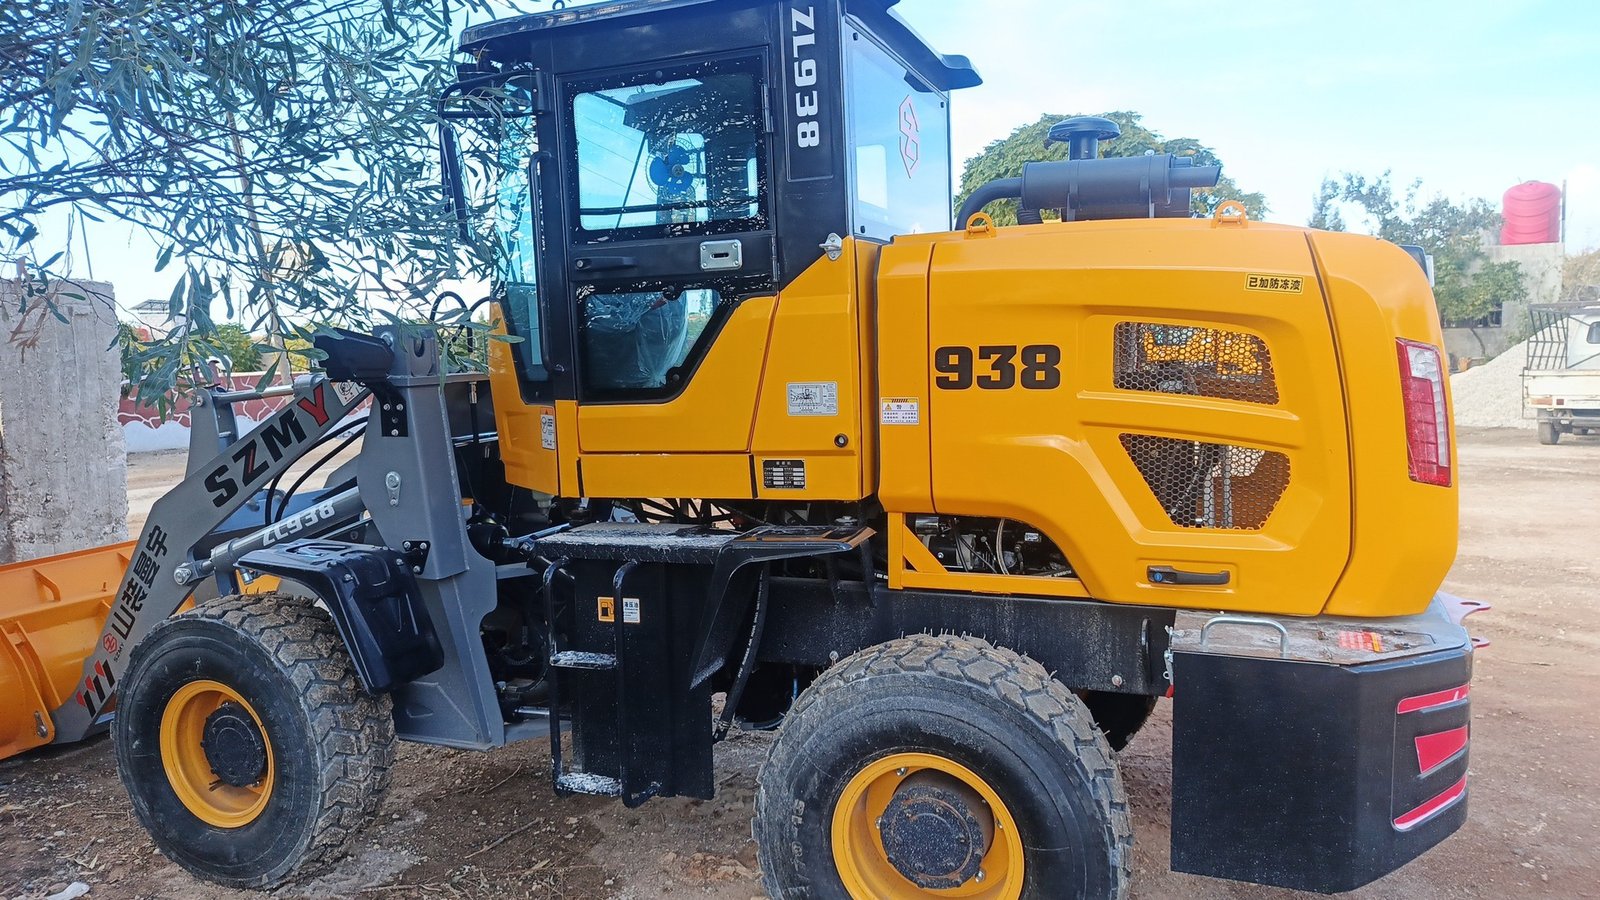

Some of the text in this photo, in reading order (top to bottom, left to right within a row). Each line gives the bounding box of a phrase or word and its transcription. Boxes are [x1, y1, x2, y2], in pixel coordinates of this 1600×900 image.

[791, 6, 820, 148] ZL938
[1248, 277, 1301, 291] 已加防冻液
[934, 344, 1061, 390] 938
[204, 382, 330, 508] SZMY
[111, 524, 168, 640] 山装曼宇
